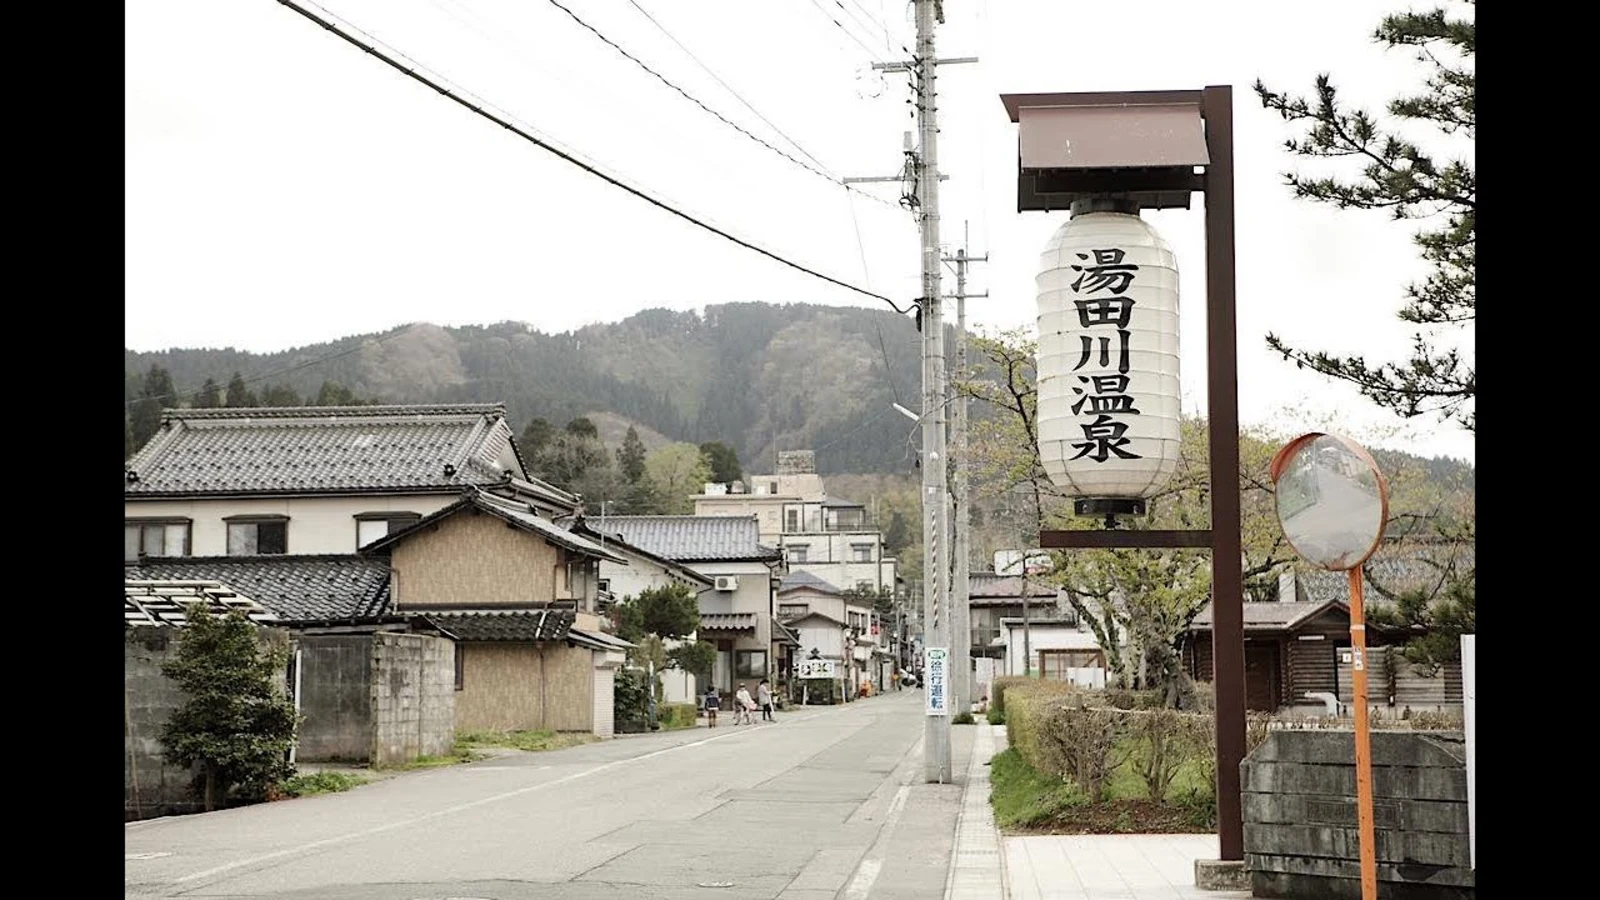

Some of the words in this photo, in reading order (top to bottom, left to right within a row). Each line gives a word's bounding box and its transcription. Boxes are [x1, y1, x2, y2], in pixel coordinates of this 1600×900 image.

[1070, 248, 1143, 463] 湯田川温泉
[930, 660, 943, 709] 徐行運転
